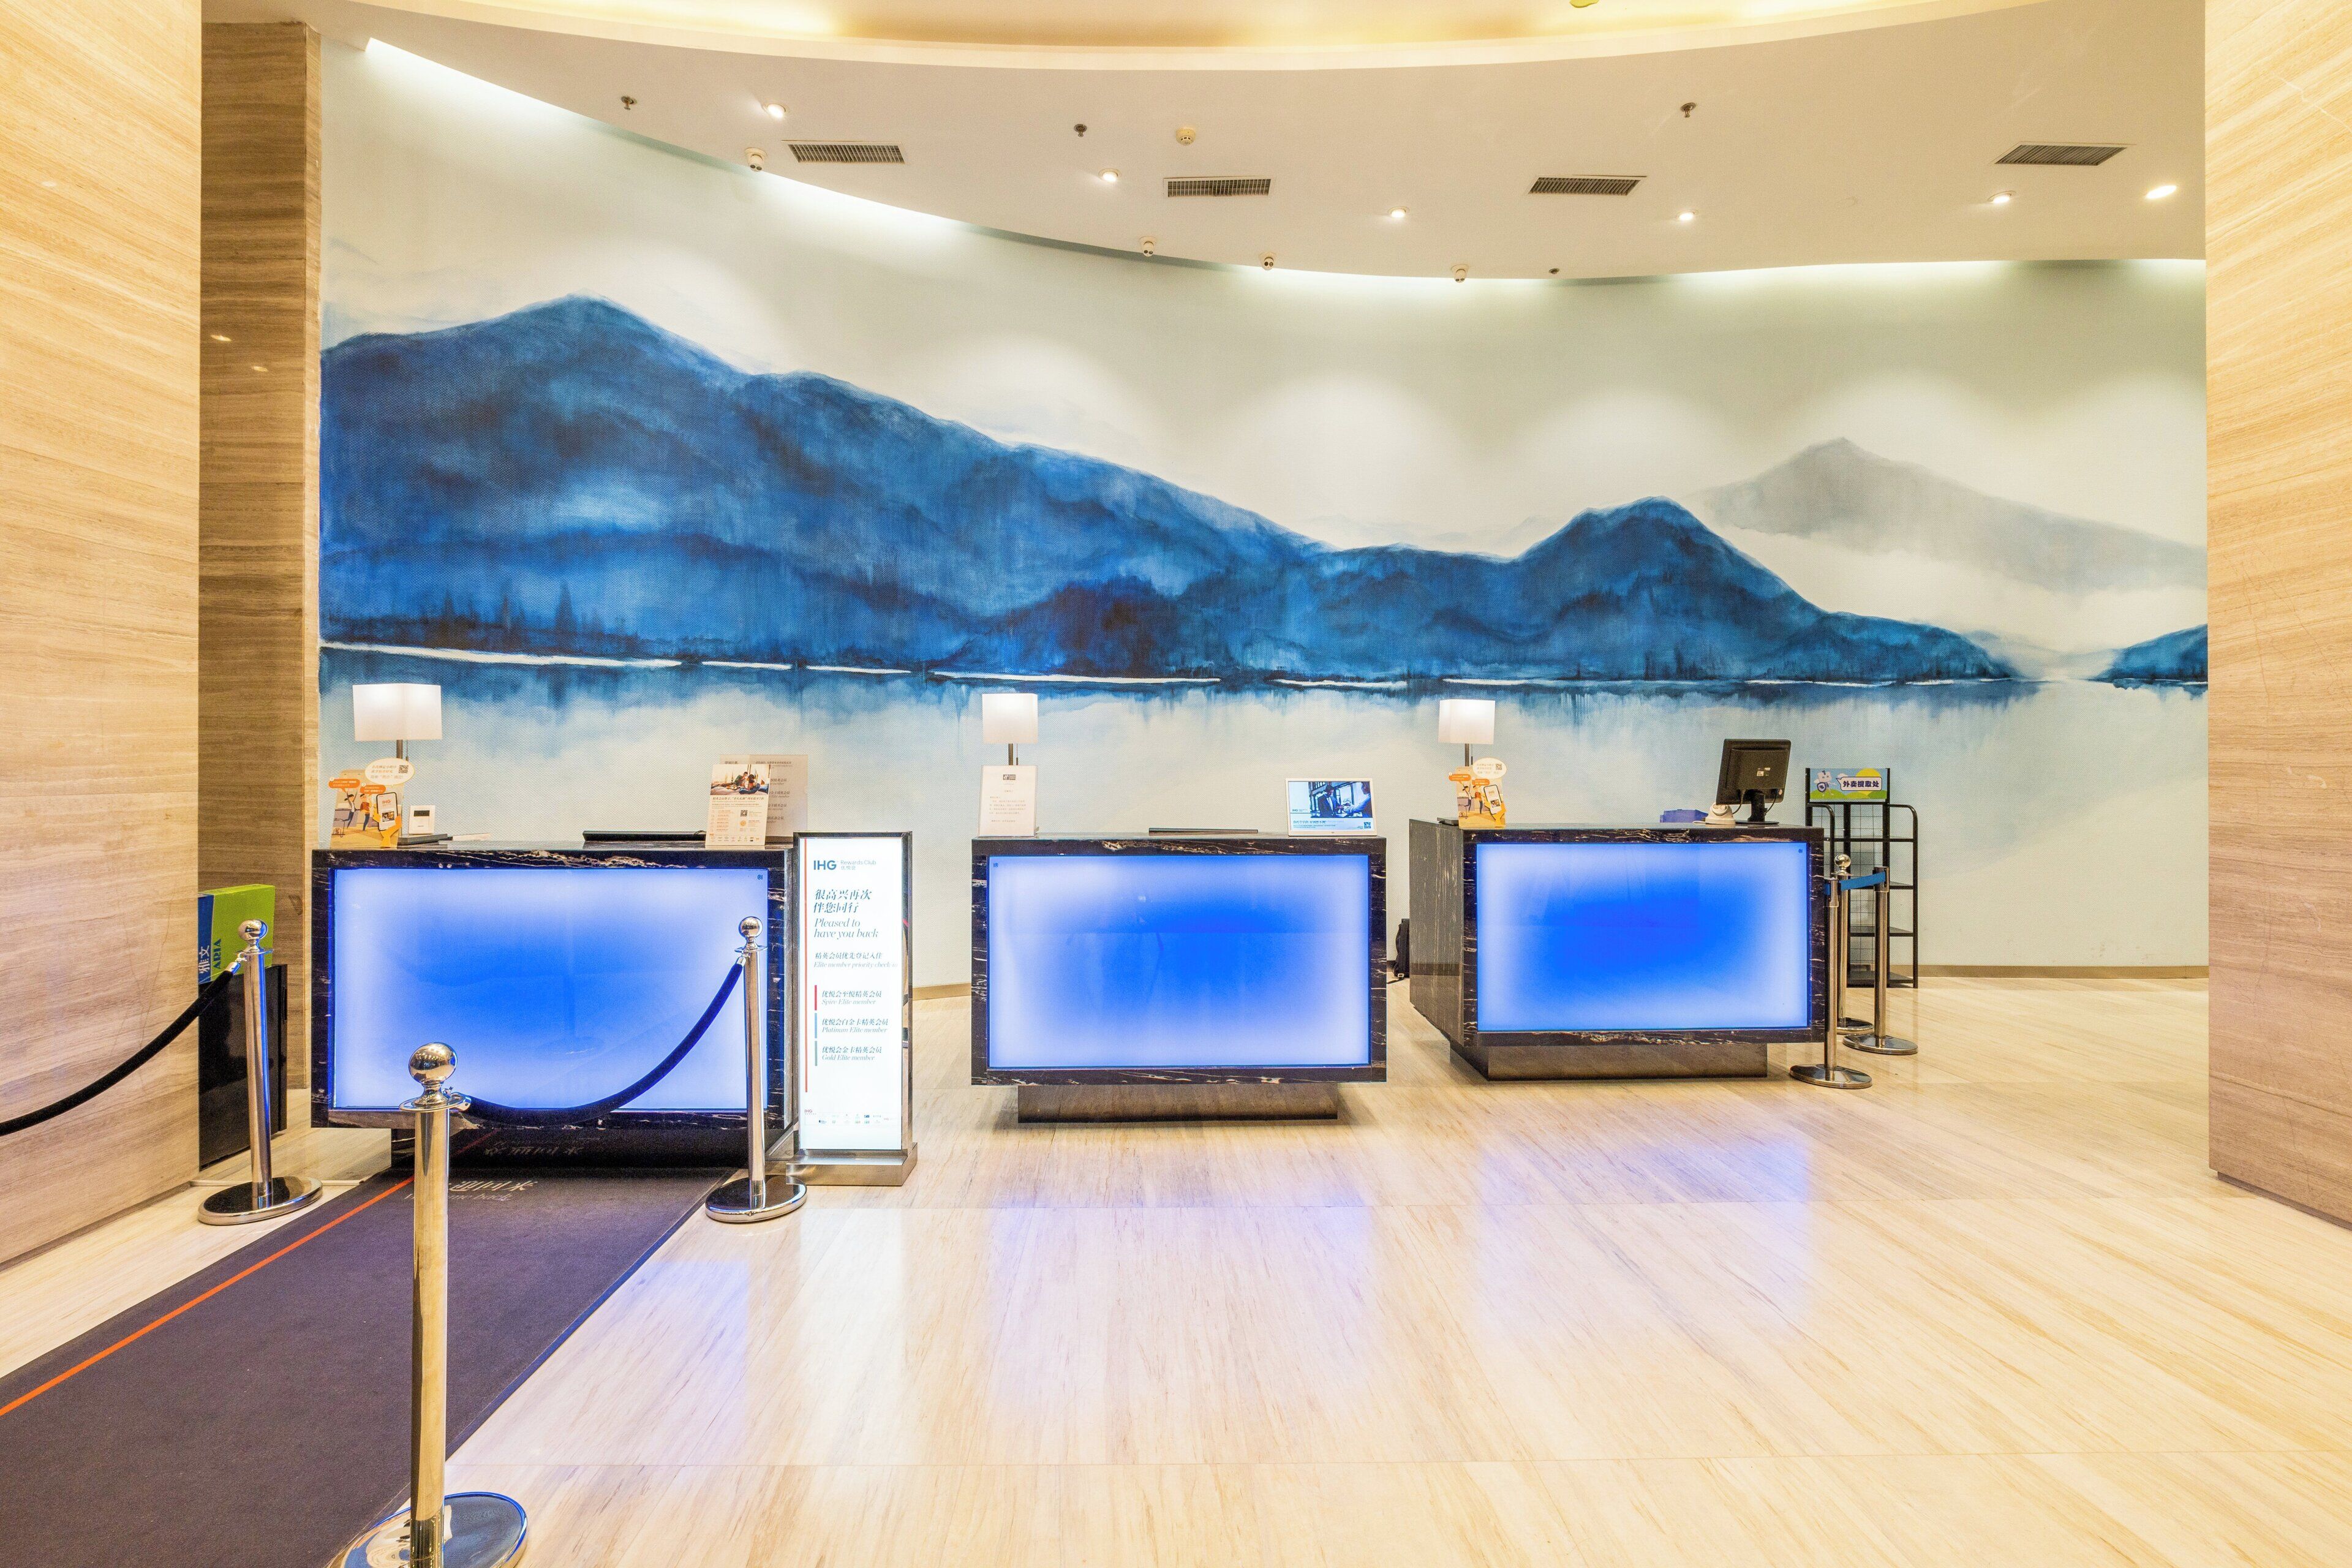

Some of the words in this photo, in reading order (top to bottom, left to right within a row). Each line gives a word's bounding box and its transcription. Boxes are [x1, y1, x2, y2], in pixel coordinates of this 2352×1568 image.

[813, 860, 837, 870] IHG
[815, 889, 872, 900] 很高兴再次
[813, 902, 859, 913] 伴您同行
[814, 918, 850, 927] Pleased
[851, 919, 861, 927] to
[814, 929, 836, 938] have
[856, 929, 878, 938] back
[448, 1180, 538, 1191] 迎回来
